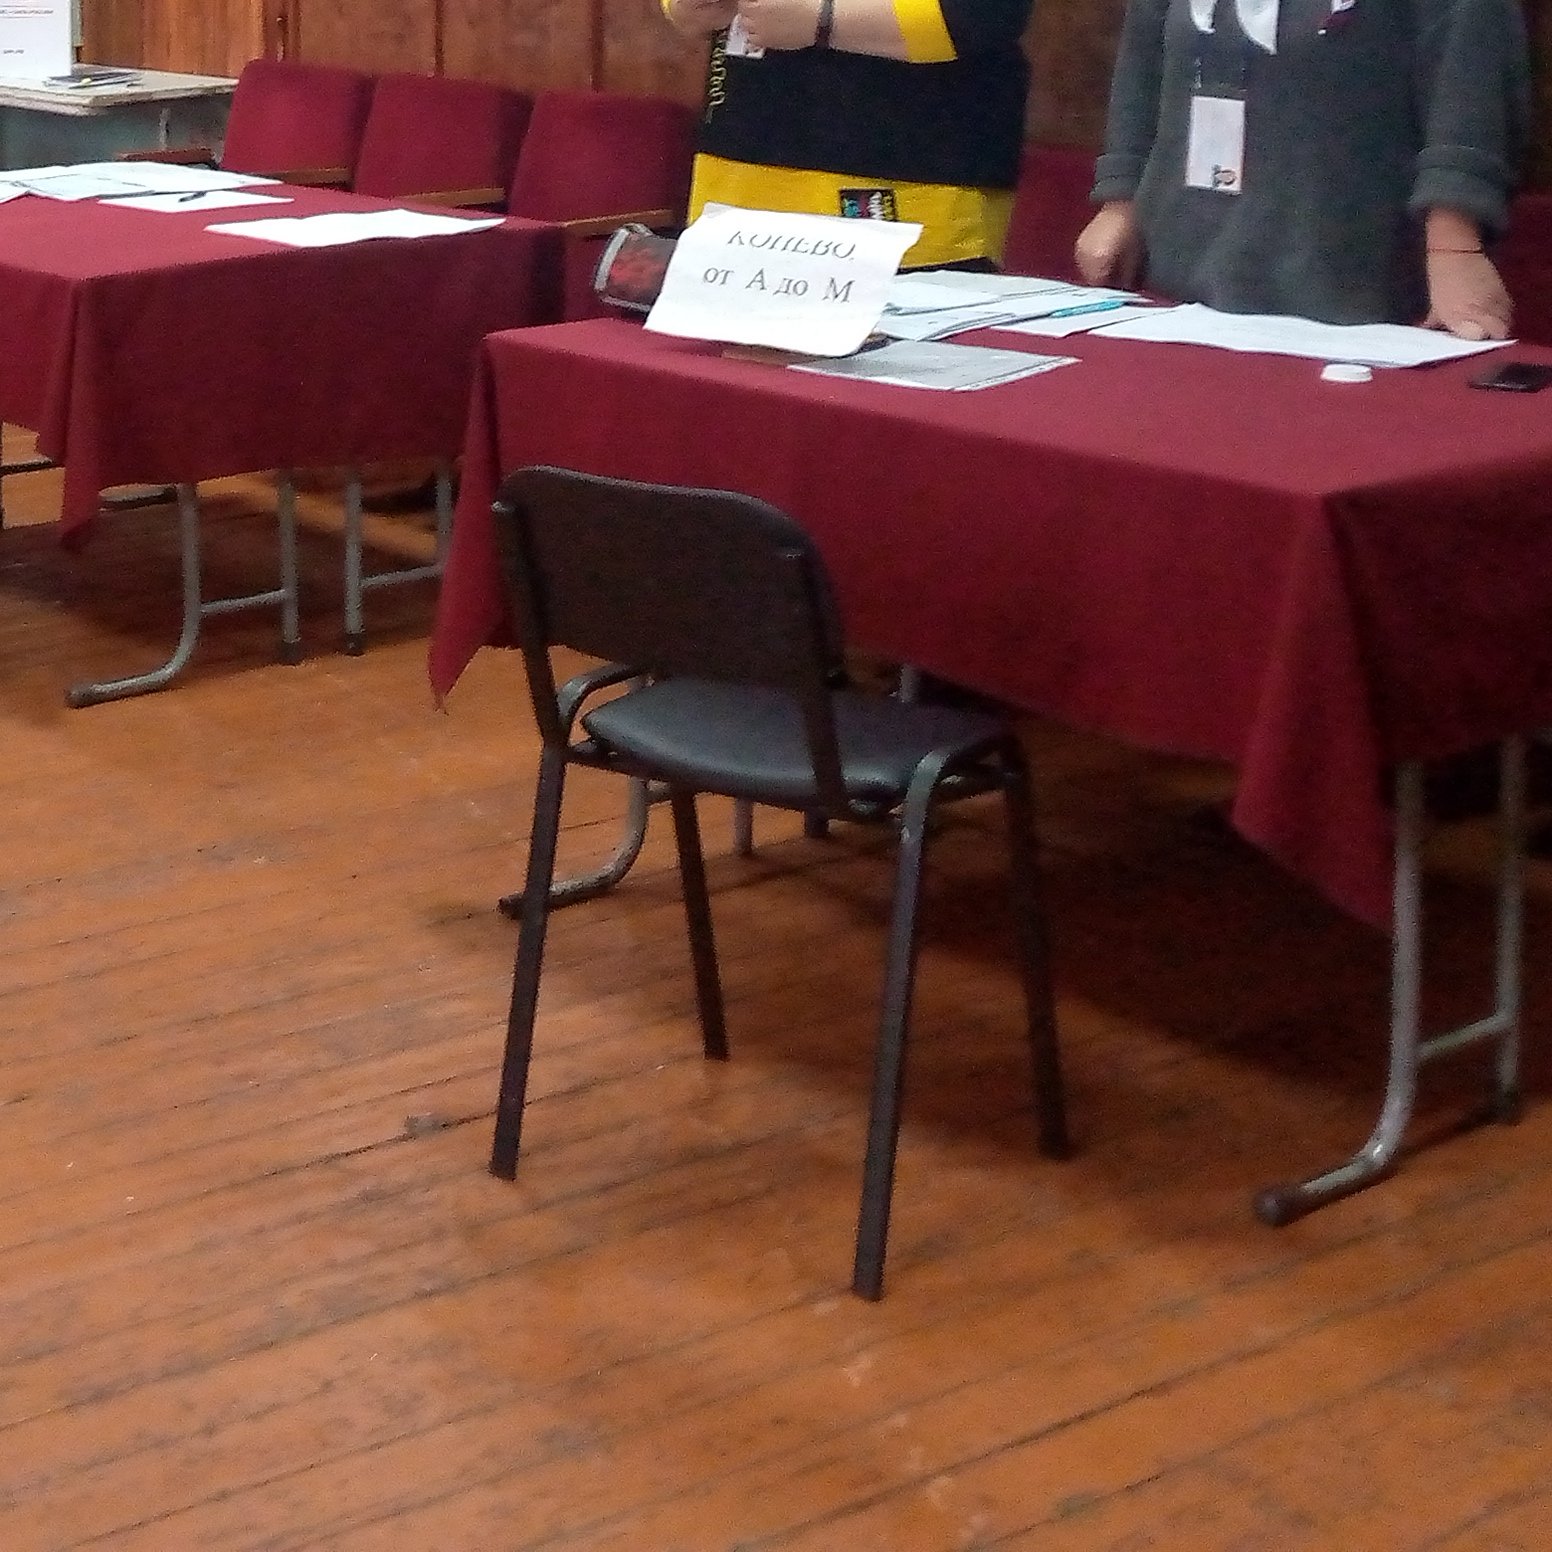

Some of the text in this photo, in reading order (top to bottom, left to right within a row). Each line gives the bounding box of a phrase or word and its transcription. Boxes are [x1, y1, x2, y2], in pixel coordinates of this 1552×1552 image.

[703, 267, 855, 303] от А до М
